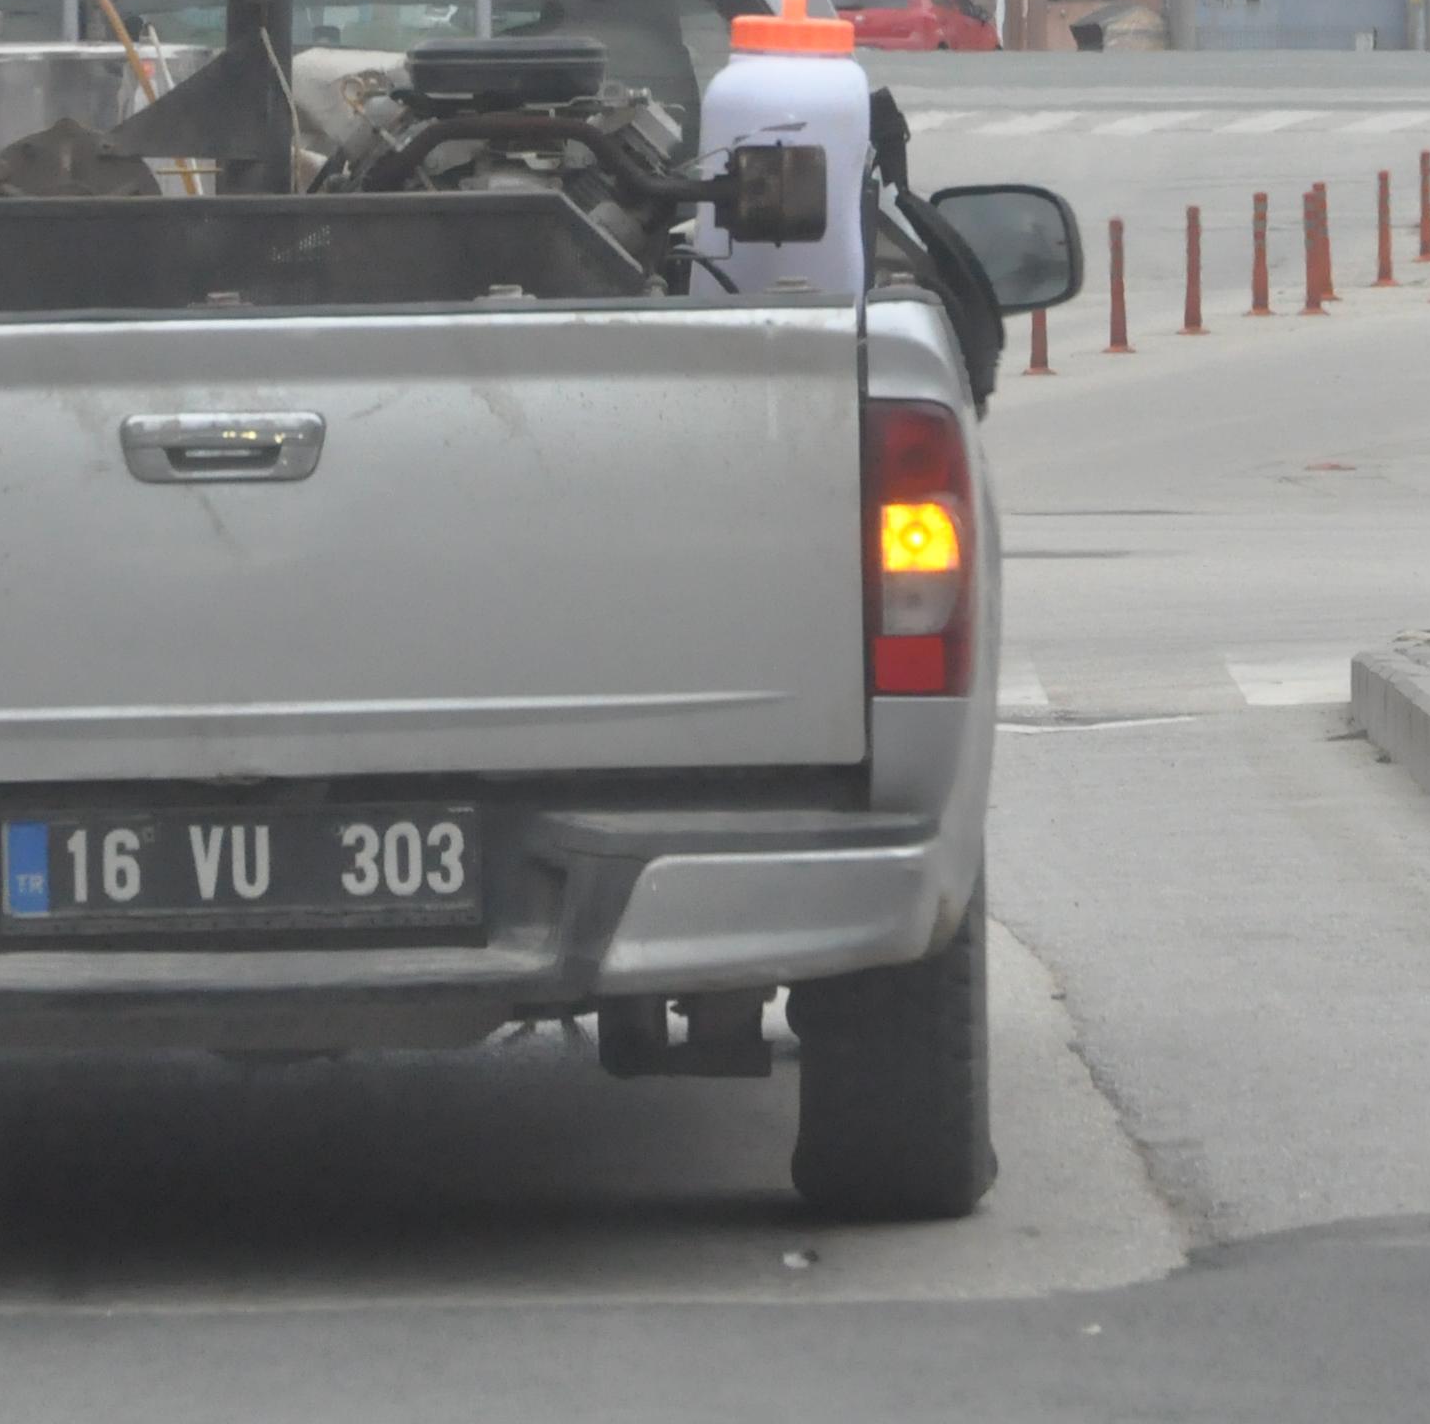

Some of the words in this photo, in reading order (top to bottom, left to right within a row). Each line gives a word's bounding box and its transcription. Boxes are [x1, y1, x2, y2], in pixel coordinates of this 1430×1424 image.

[15, 874, 46, 896] TR
[66, 828, 142, 903] 16
[187, 824, 271, 900] VU
[340, 820, 466, 897] 303
